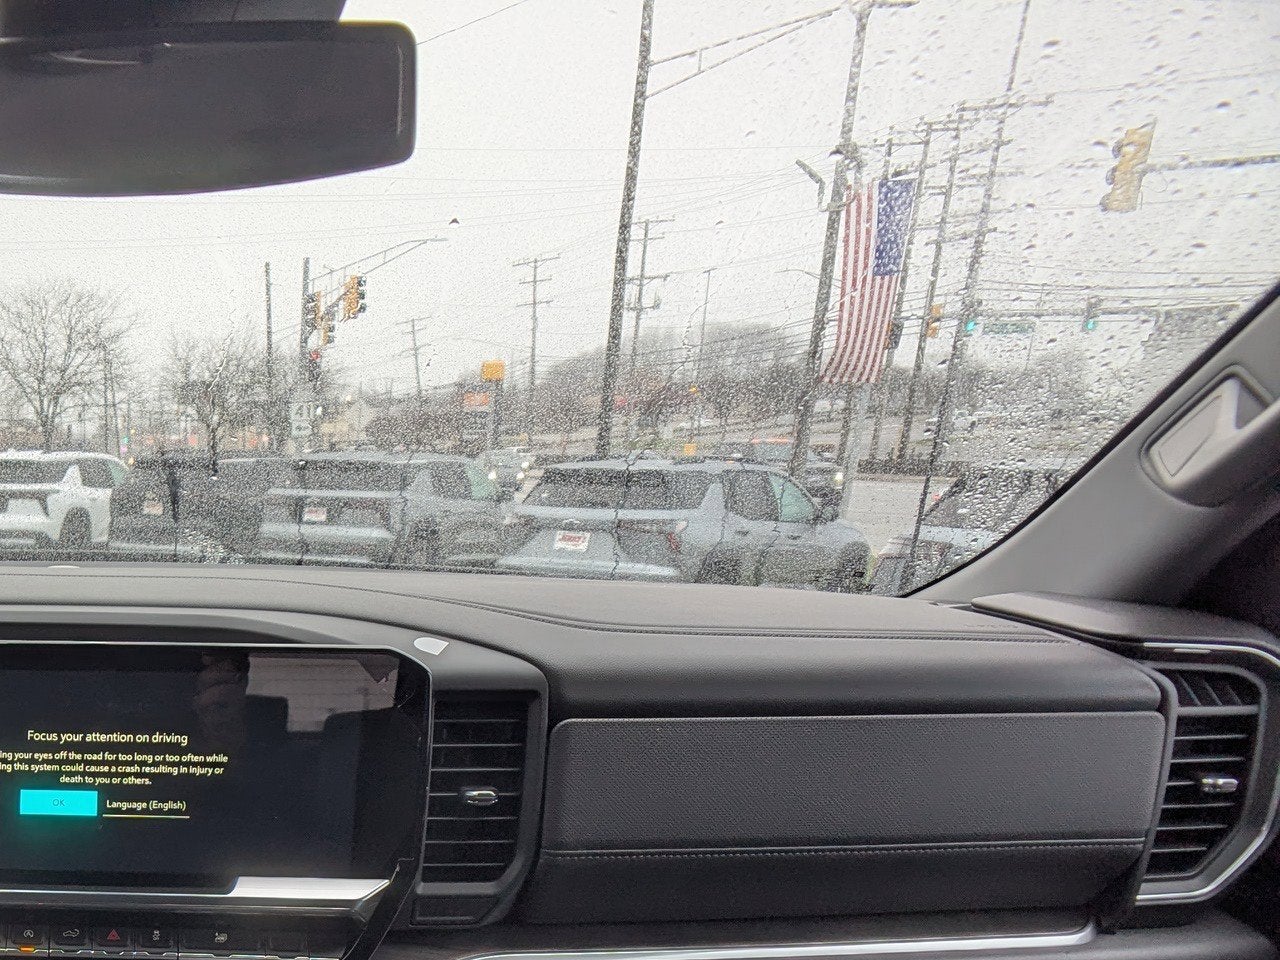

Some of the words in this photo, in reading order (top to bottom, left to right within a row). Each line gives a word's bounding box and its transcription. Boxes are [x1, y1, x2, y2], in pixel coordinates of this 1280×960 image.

[27, 730, 58, 741] Focus
[59, 733, 84, 744] your
[85, 731, 134, 743] attention
[135, 734, 149, 743] on
[151, 732, 188, 746] driving
[14, 752, 32, 760] your
[33, 753, 53, 761] eyes
[54, 750, 68, 760] off
[68, 751, 82, 760] the
[83, 751, 103, 760] road
[104, 752, 116, 761] for
[118, 753, 133, 761] too
[134, 752, 153, 763] long
[165, 754, 180, 762] too
[181, 753, 204, 762] often
[206, 753, 228, 763] while
[13, 762, 29, 771] this
[30, 763, 60, 773] system
[61, 763, 84, 772] could
[117, 764, 140, 773] crash
[141, 764, 178, 775] resulting
[180, 765, 188, 773] in
[189, 765, 213, 777] injury
[59, 774, 83, 783] death
[84, 775, 94, 783] to
[95, 776, 111, 786] you
[122, 775, 152, 785] others.
[52, 798, 65, 807] OK
[106, 799, 147, 811] Language
[148, 800, 187, 811] (English)
